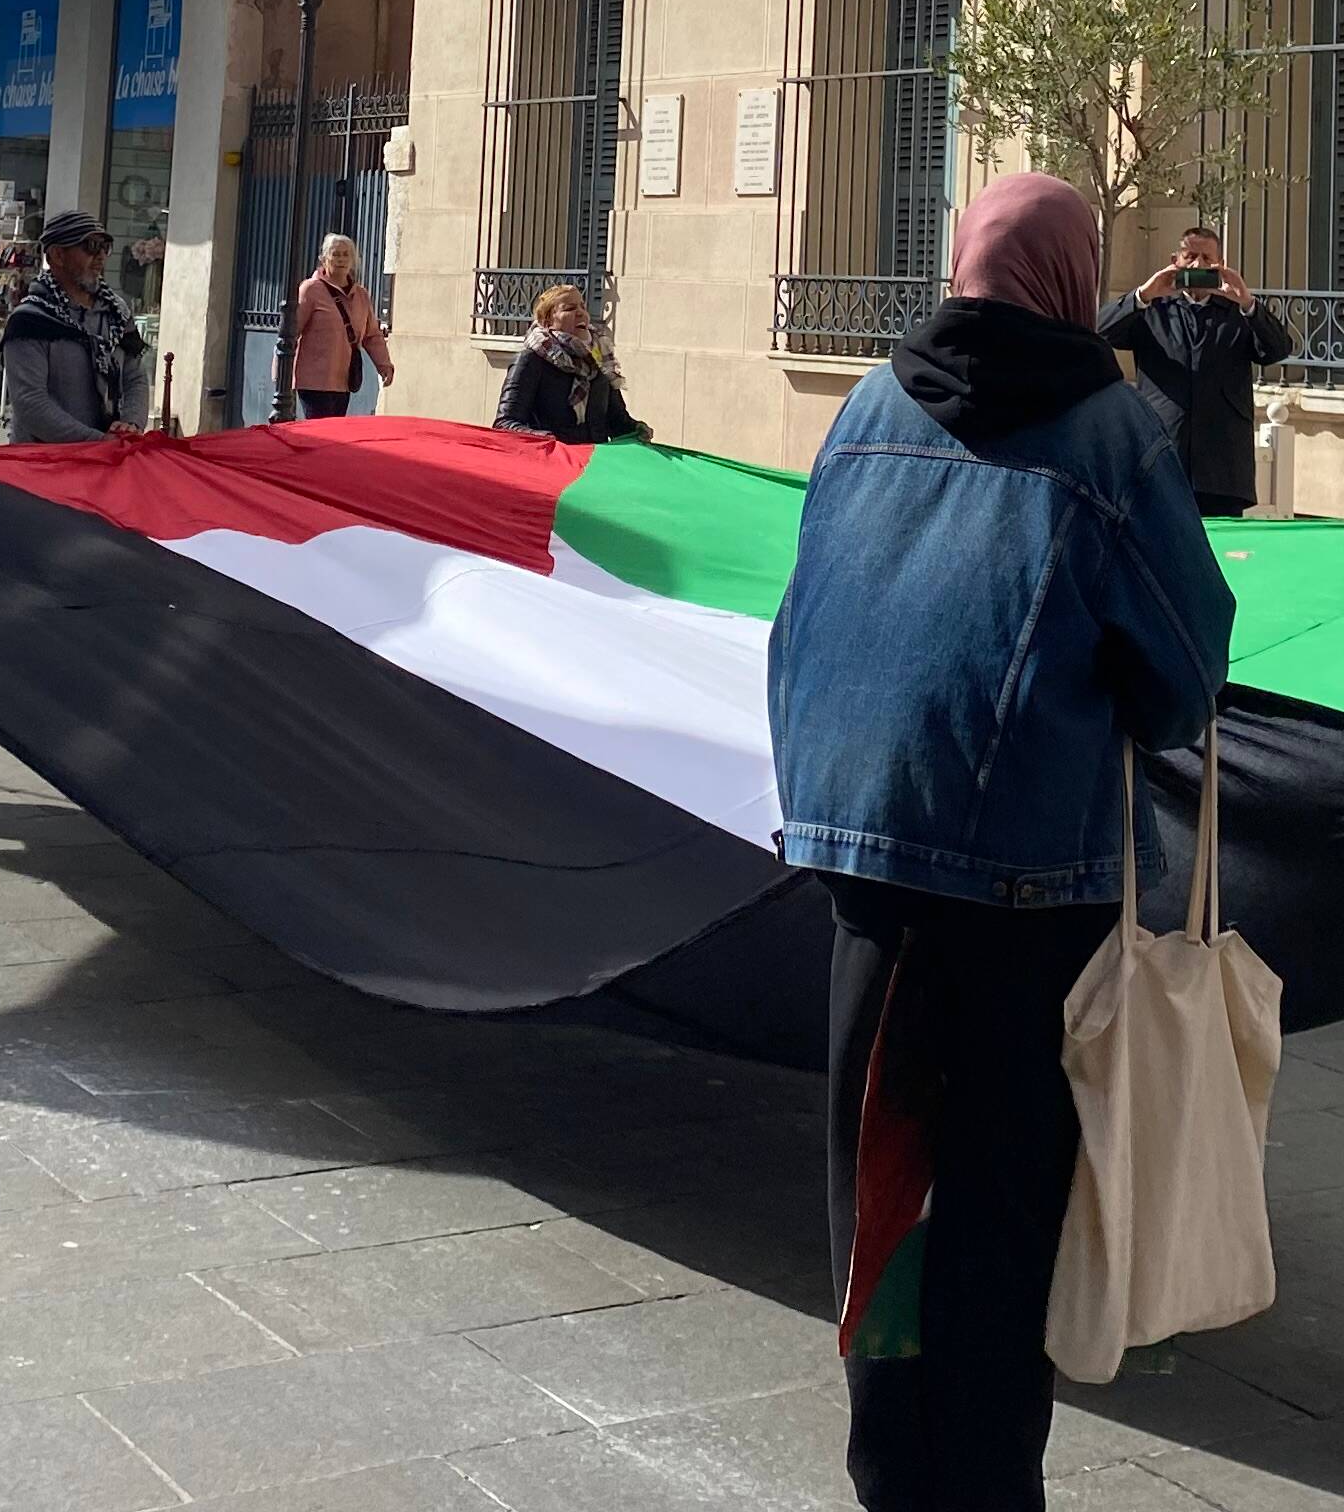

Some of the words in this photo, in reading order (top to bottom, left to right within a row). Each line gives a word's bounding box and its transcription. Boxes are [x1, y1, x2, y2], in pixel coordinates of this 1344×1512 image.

[3, 72, 37, 109] chaise
[115, 64, 130, 100] La
[131, 59, 166, 98] chaise
